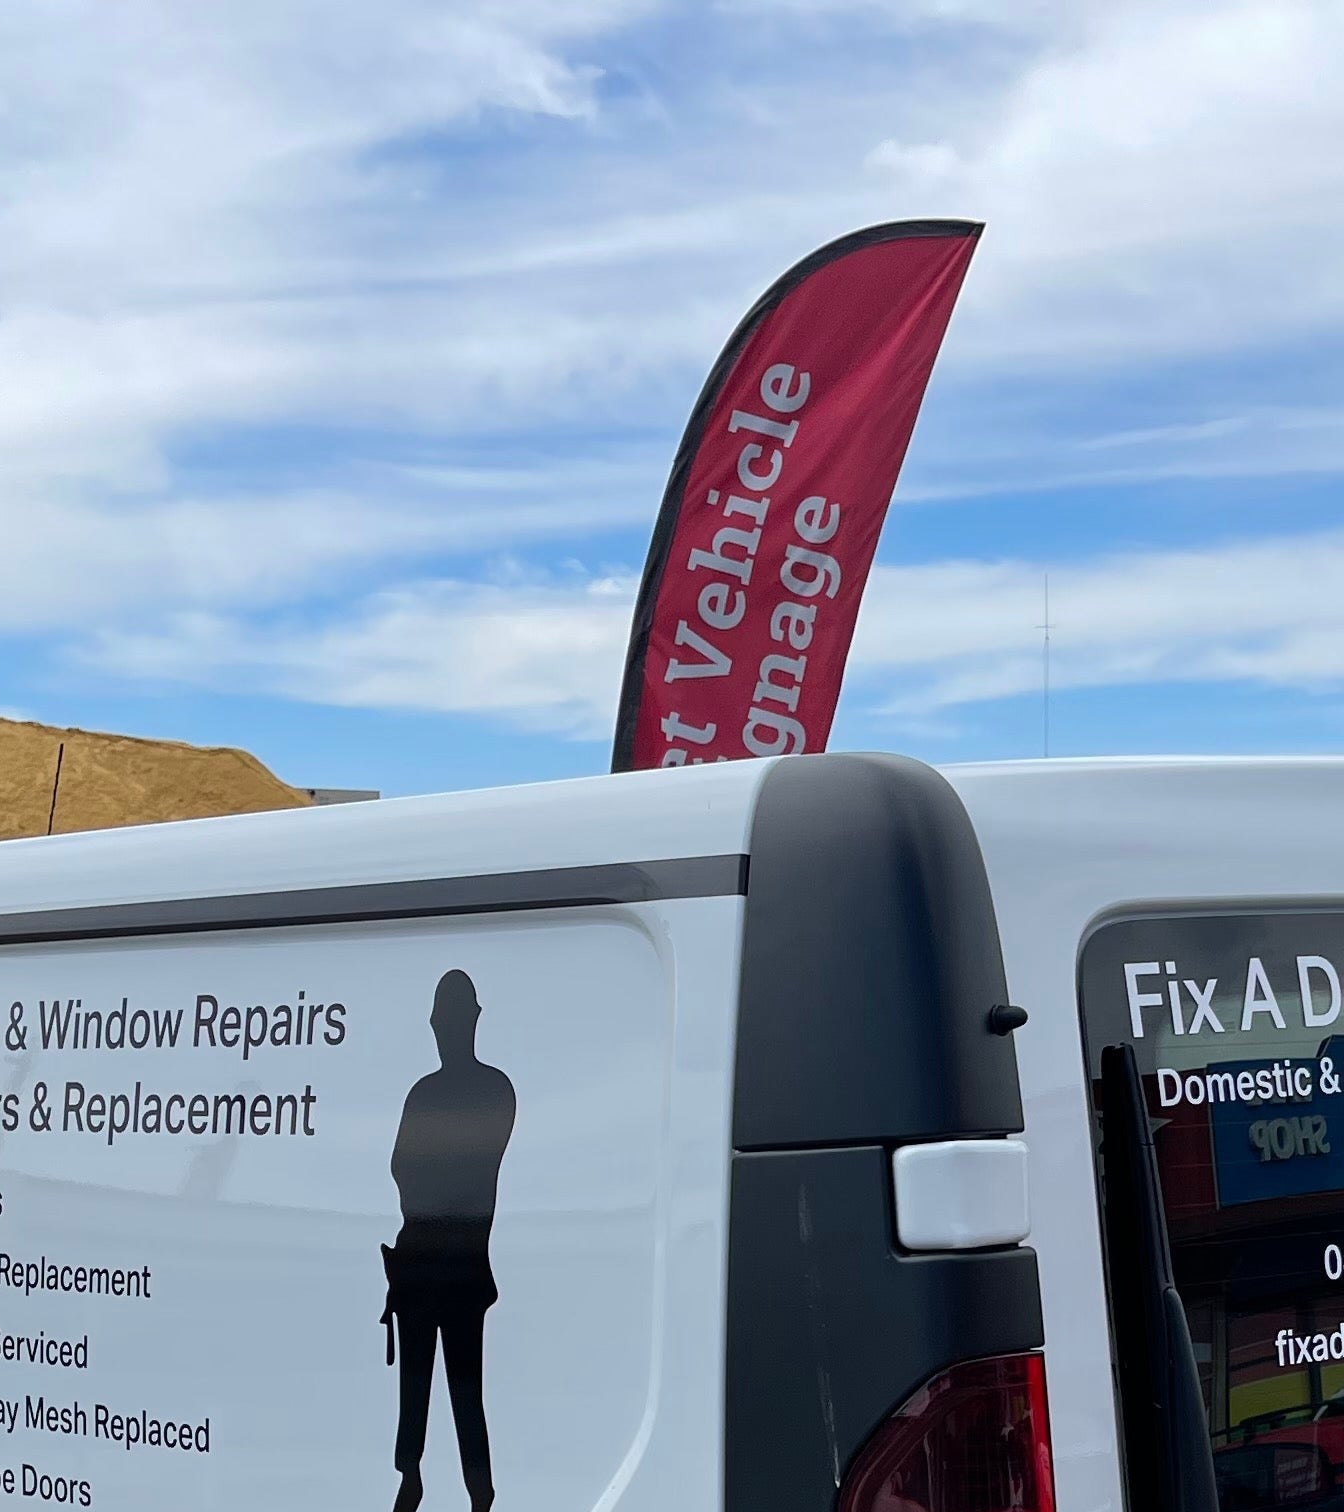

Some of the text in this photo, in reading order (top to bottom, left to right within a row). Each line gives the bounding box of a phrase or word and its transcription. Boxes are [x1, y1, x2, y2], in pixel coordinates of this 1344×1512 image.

[660, 362, 811, 768] t Vehicle
[742, 495, 842, 760] gnage
[5, 1001, 28, 1051] &
[39, 998, 183, 1050] Window
[193, 991, 347, 1060] Repairs
[1123, 961, 1225, 1039] Fix
[1240, 957, 1287, 1031] A
[28, 1082, 52, 1133] &
[63, 1082, 317, 1146] Replacement
[1158, 1058, 1312, 1107] Domestic
[1318, 1057, 1342, 1094] &
[25, 1395, 87, 1437] Mesh
[94, 1404, 211, 1453] Replaced
[22, 1464, 91, 1507] Doors
